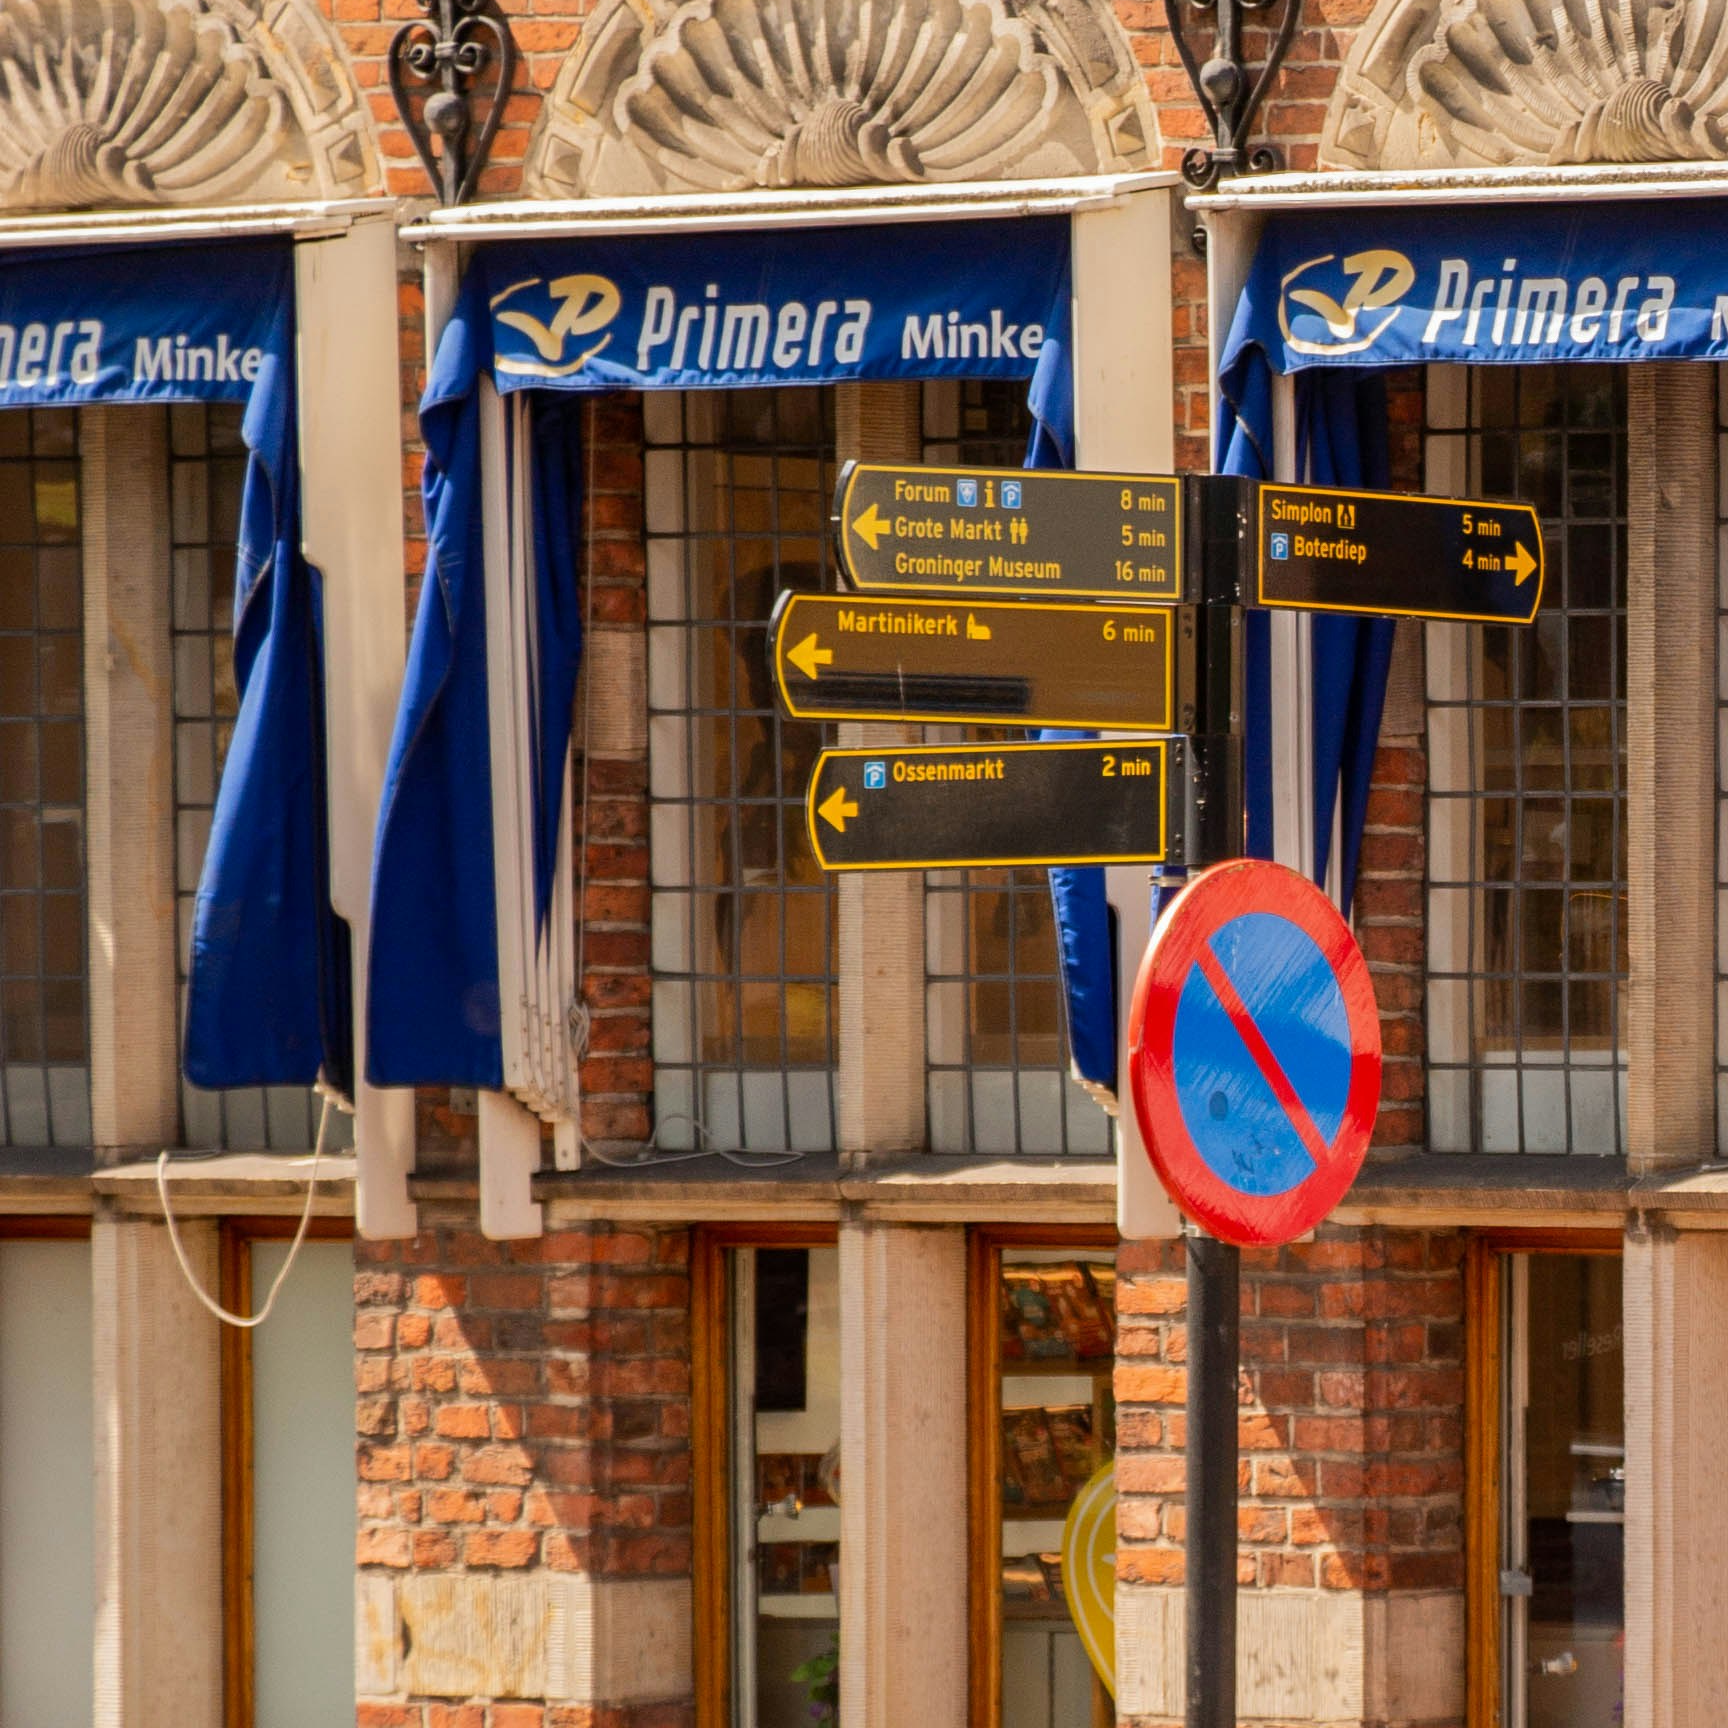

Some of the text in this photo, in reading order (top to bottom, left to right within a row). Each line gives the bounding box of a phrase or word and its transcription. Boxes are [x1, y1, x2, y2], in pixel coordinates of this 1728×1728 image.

[1421, 257, 1677, 347] Primera
[637, 283, 1045, 372] Primera Minke
[134, 333, 263, 382] Minke
[895, 479, 950, 503] Forum
[1120, 489, 1133, 511] 8
[1138, 493, 1166, 512] min
[895, 516, 1166, 547] Grote Markt 5 min
[1271, 499, 1501, 537] Simplon 5 min
[895, 552, 1166, 582] Groninger Museum 16 min
[1294, 535, 1367, 565] Boterdiep
[1462, 549, 1473, 569] 4
[1477, 554, 1501, 572] min
[838, 610, 1155, 642] Martinikerk 6 min
[893, 758, 1005, 783] Ossenmarkt
[1102, 755, 1116, 777] 2
[1121, 757, 1151, 777] min
